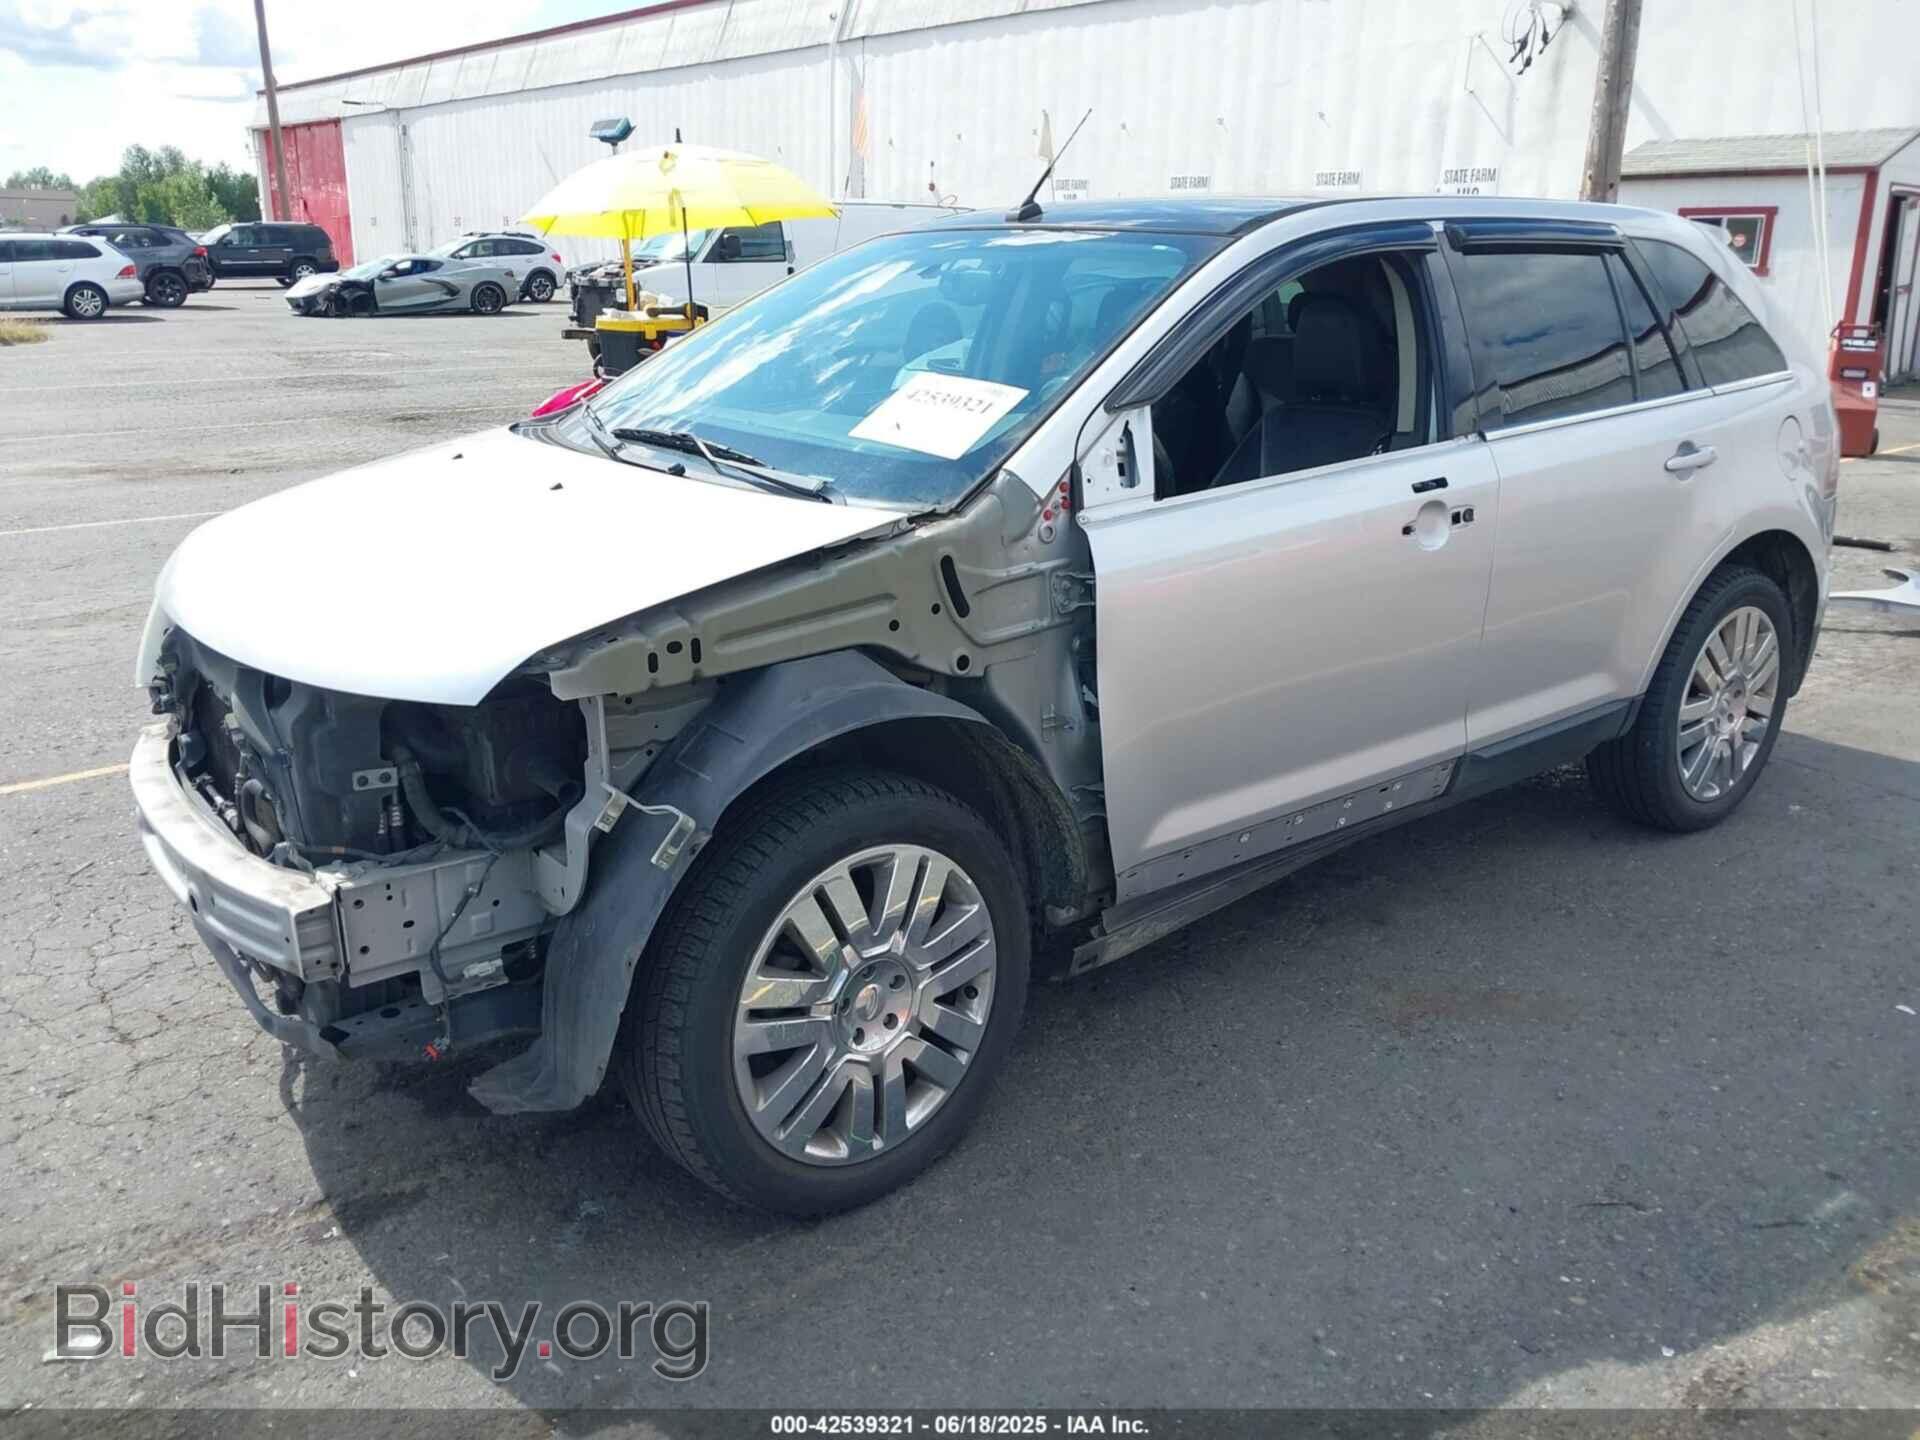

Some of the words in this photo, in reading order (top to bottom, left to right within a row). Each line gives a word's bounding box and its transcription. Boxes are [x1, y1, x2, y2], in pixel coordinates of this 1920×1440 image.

[1170, 176, 1188, 190] STATE
[1189, 175, 1208, 189] FARM
[1315, 172, 1336, 186] STATE
[1337, 171, 1360, 185] FARM
[1443, 169, 1469, 184] STATE
[1470, 168, 1497, 183] FARM
